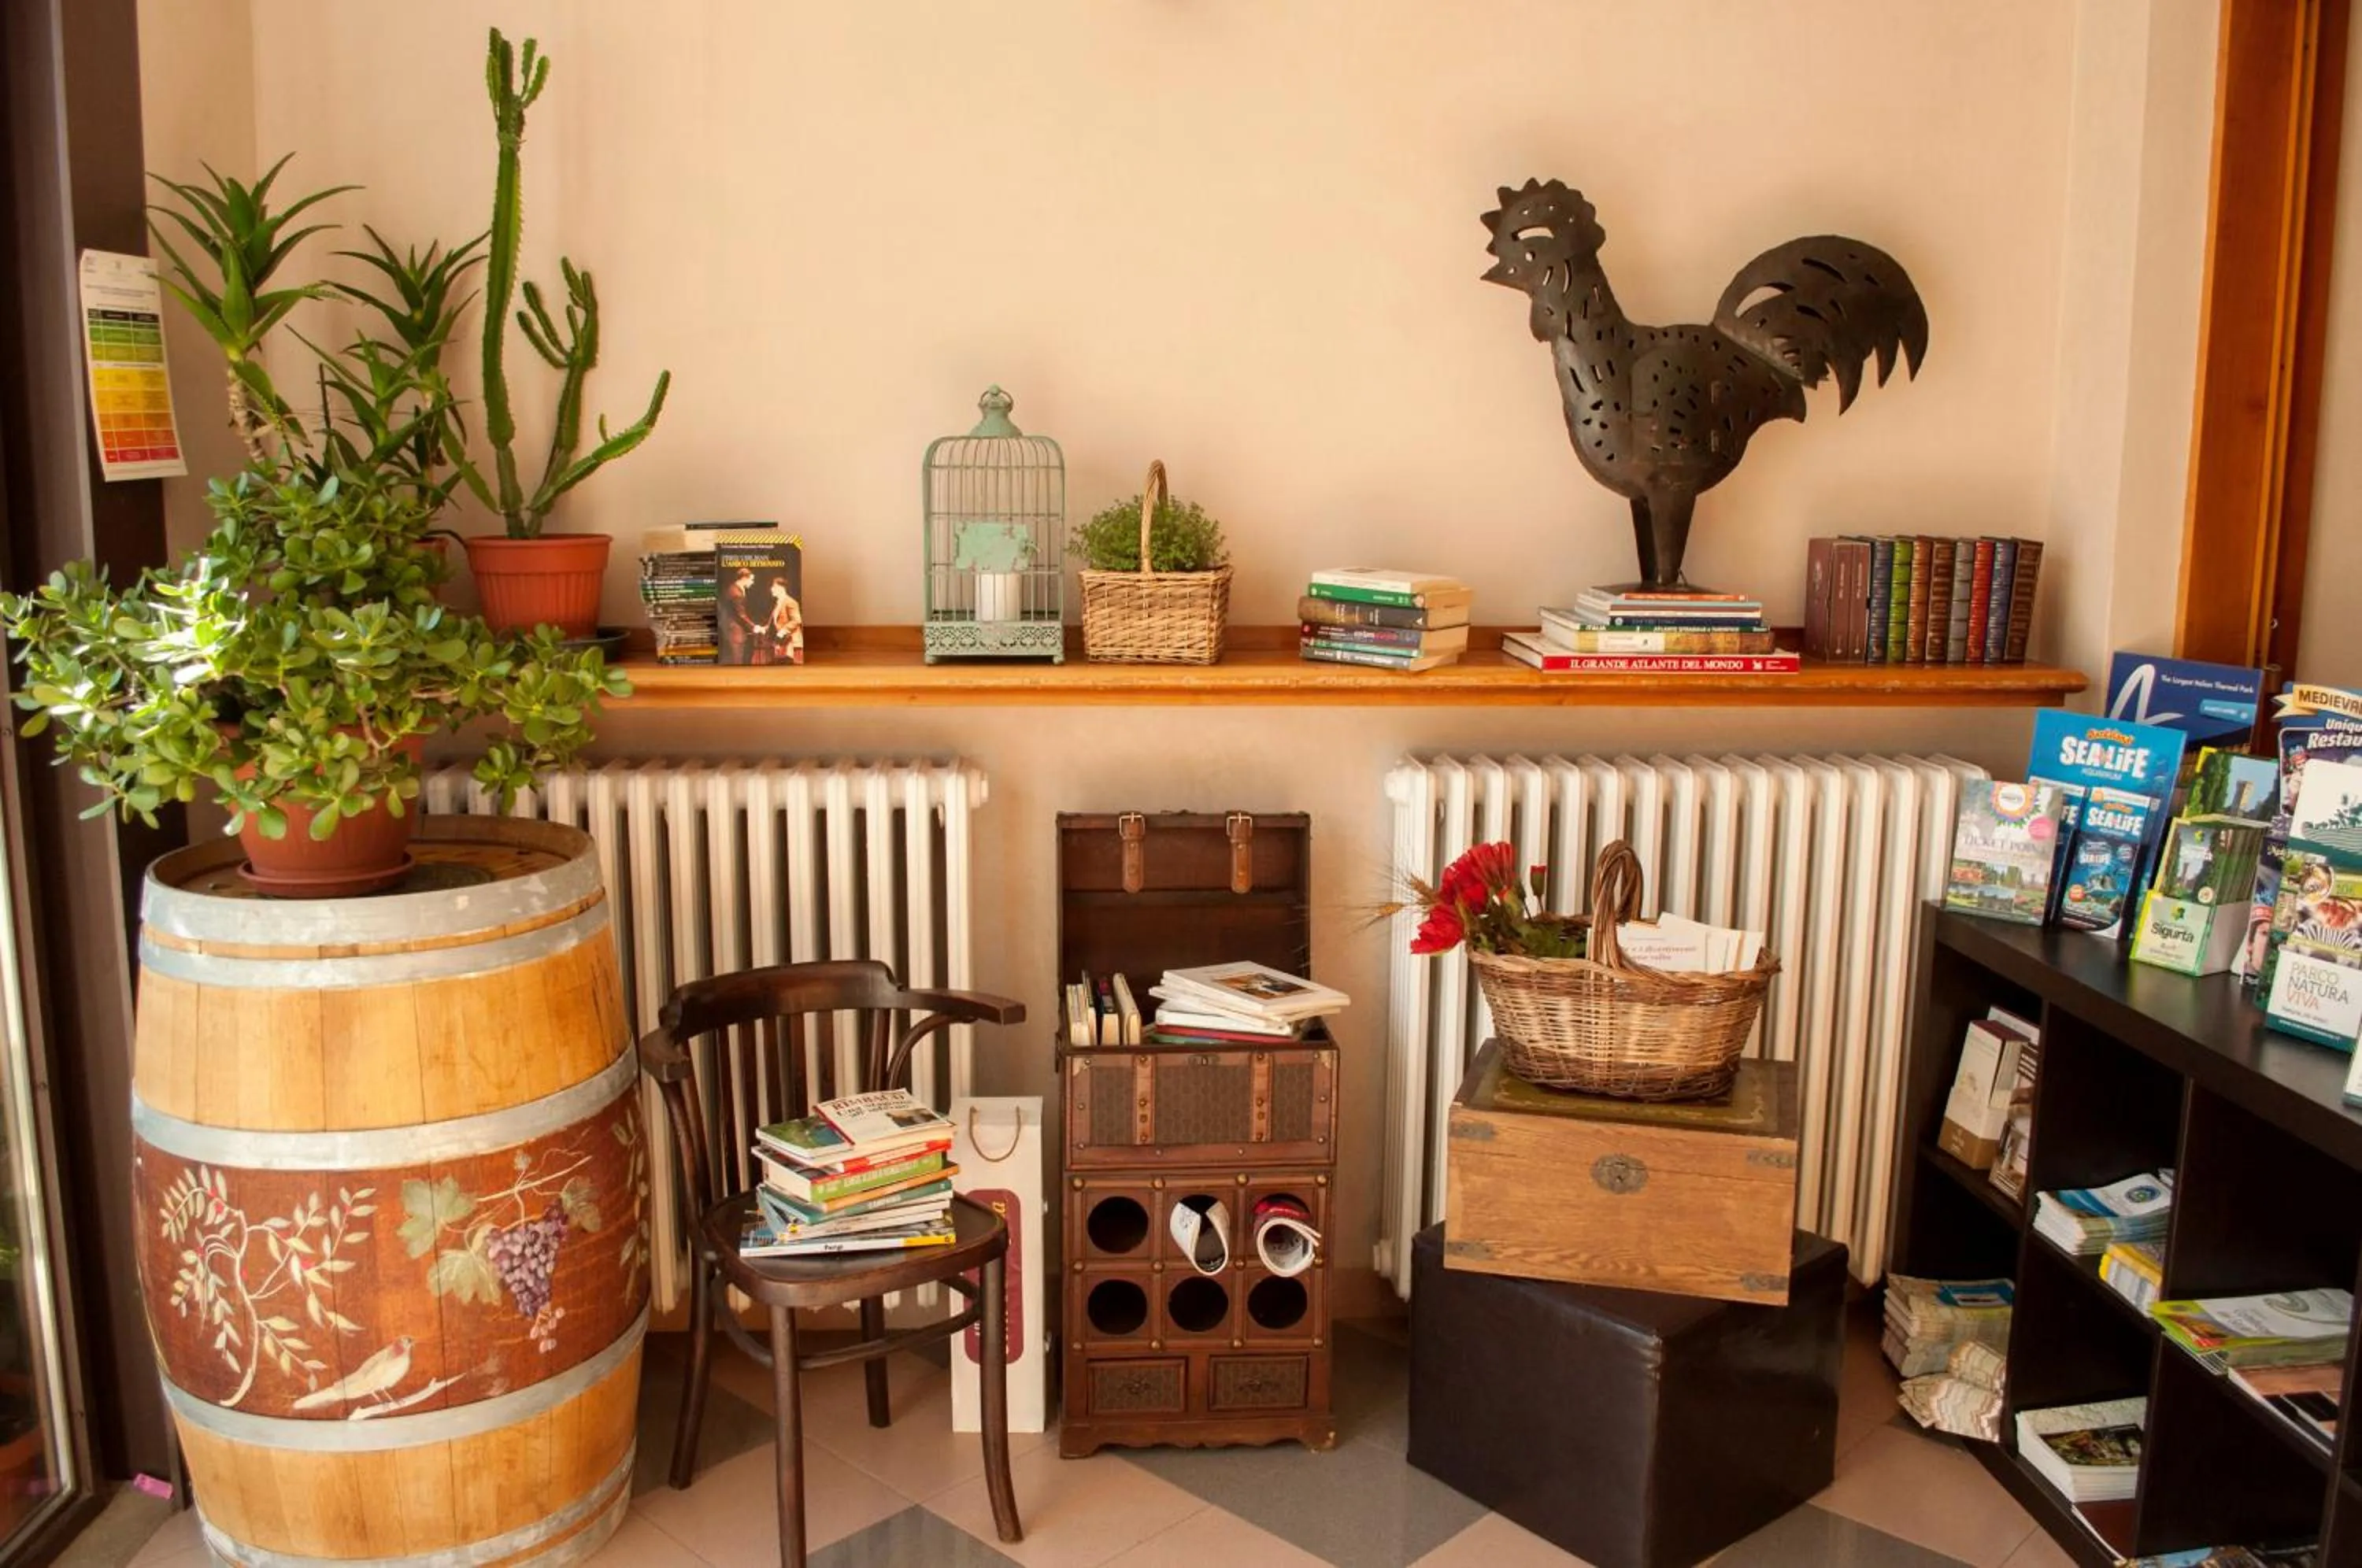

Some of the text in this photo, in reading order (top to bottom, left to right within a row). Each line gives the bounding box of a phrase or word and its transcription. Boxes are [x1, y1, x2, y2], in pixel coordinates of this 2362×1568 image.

[1582, 659, 1629, 669] GRANDE
[1631, 660, 1680, 669] ATLANTE
[1682, 660, 1703, 669] DEL
[1704, 660, 1744, 669] MONDO
[2238, 684, 2254, 694] Park
[2325, 717, 2362, 734] Uniqu
[2307, 732, 2362, 749] Restau
[2290, 962, 2339, 984] PARCO
[2288, 975, 2349, 1004] NATURA
[2286, 990, 2319, 1011] VIVA
